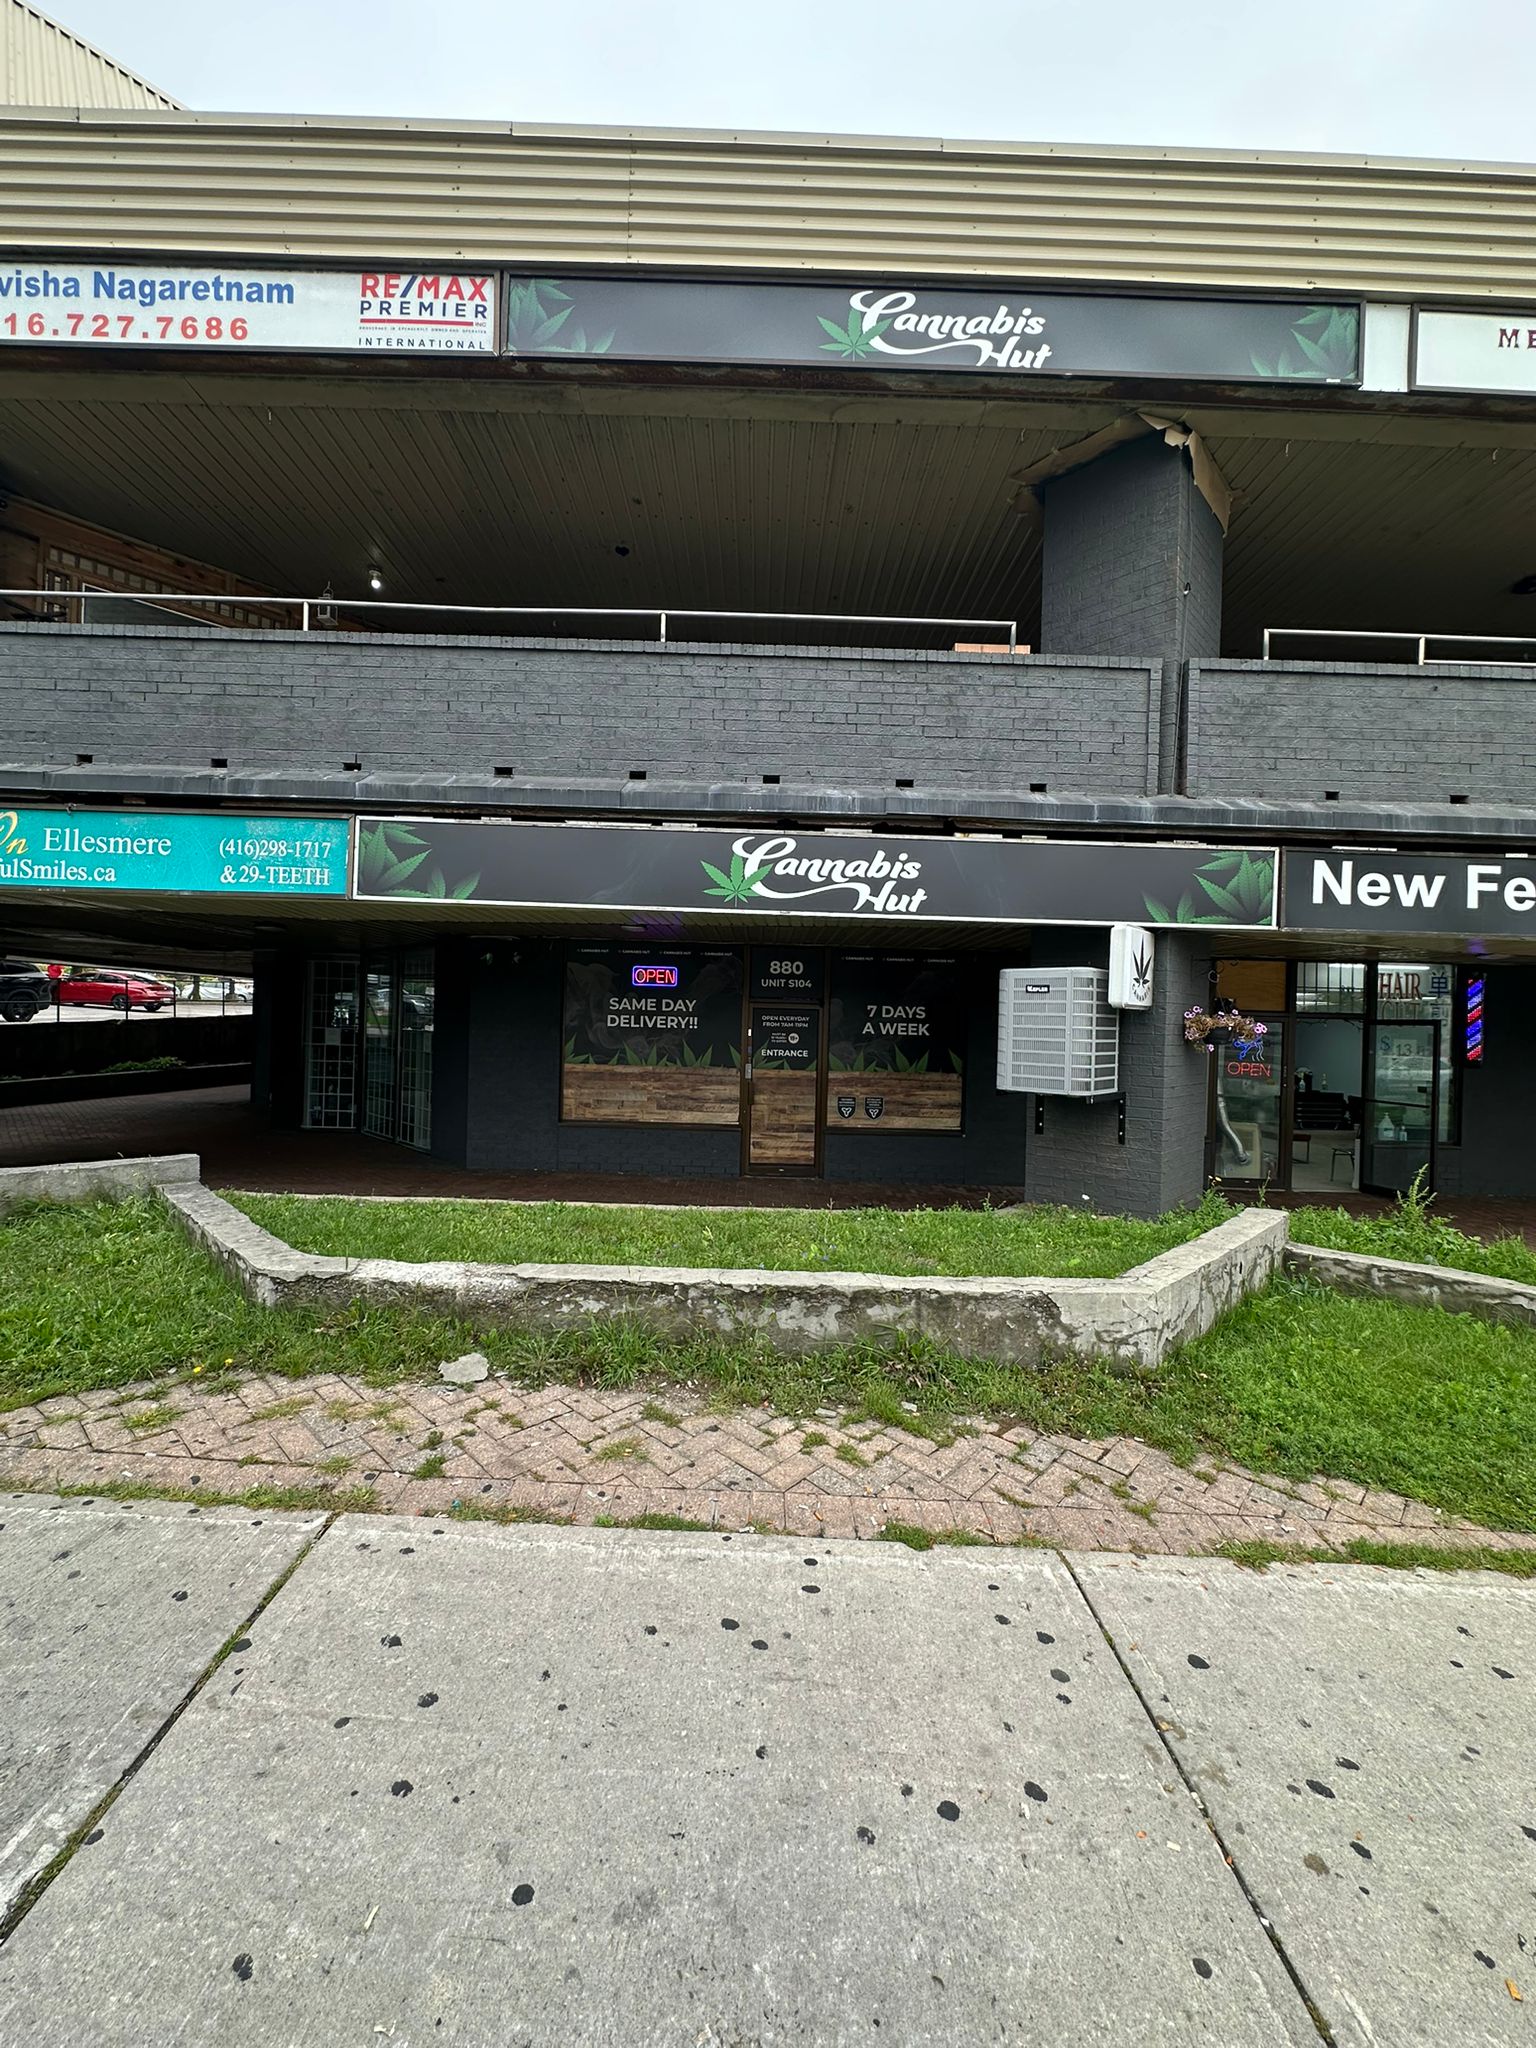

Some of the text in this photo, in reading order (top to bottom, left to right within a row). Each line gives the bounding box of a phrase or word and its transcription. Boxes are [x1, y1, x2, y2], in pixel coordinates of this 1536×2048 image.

[94, 272, 294, 307] Nagaretnam
[361, 273, 489, 302] RE/MAX
[360, 300, 488, 319] PREMIER
[4, 312, 249, 340] 16.727.7686
[850, 291, 1047, 356] Cannabis
[358, 337, 486, 350] INTERNATIONAL
[976, 336, 1053, 369] Hut
[43, 827, 172, 856] Ellesmere
[219, 838, 331, 860] (416)298-1717
[0, 857, 117, 883] ulSmiles.ca
[732, 836, 922, 899] Cannabis
[853, 880, 928, 913] Hut
[1312, 859, 1536, 912] New Fe
[634, 968, 677, 985] OPEN
[769, 960, 804, 975] 880
[761, 979, 812, 988] UNIT S104
[1379, 972, 1421, 1000] HAIR
[609, 997, 697, 1012] SAME DAY
[867, 1005, 926, 1019] 7 DAYS
[607, 1014, 699, 1029] DELIVERY!!
[862, 1022, 930, 1036] A WEEK
[761, 1048, 808, 1057] ENTRANCE
[1227, 1062, 1271, 1078] OPEN
